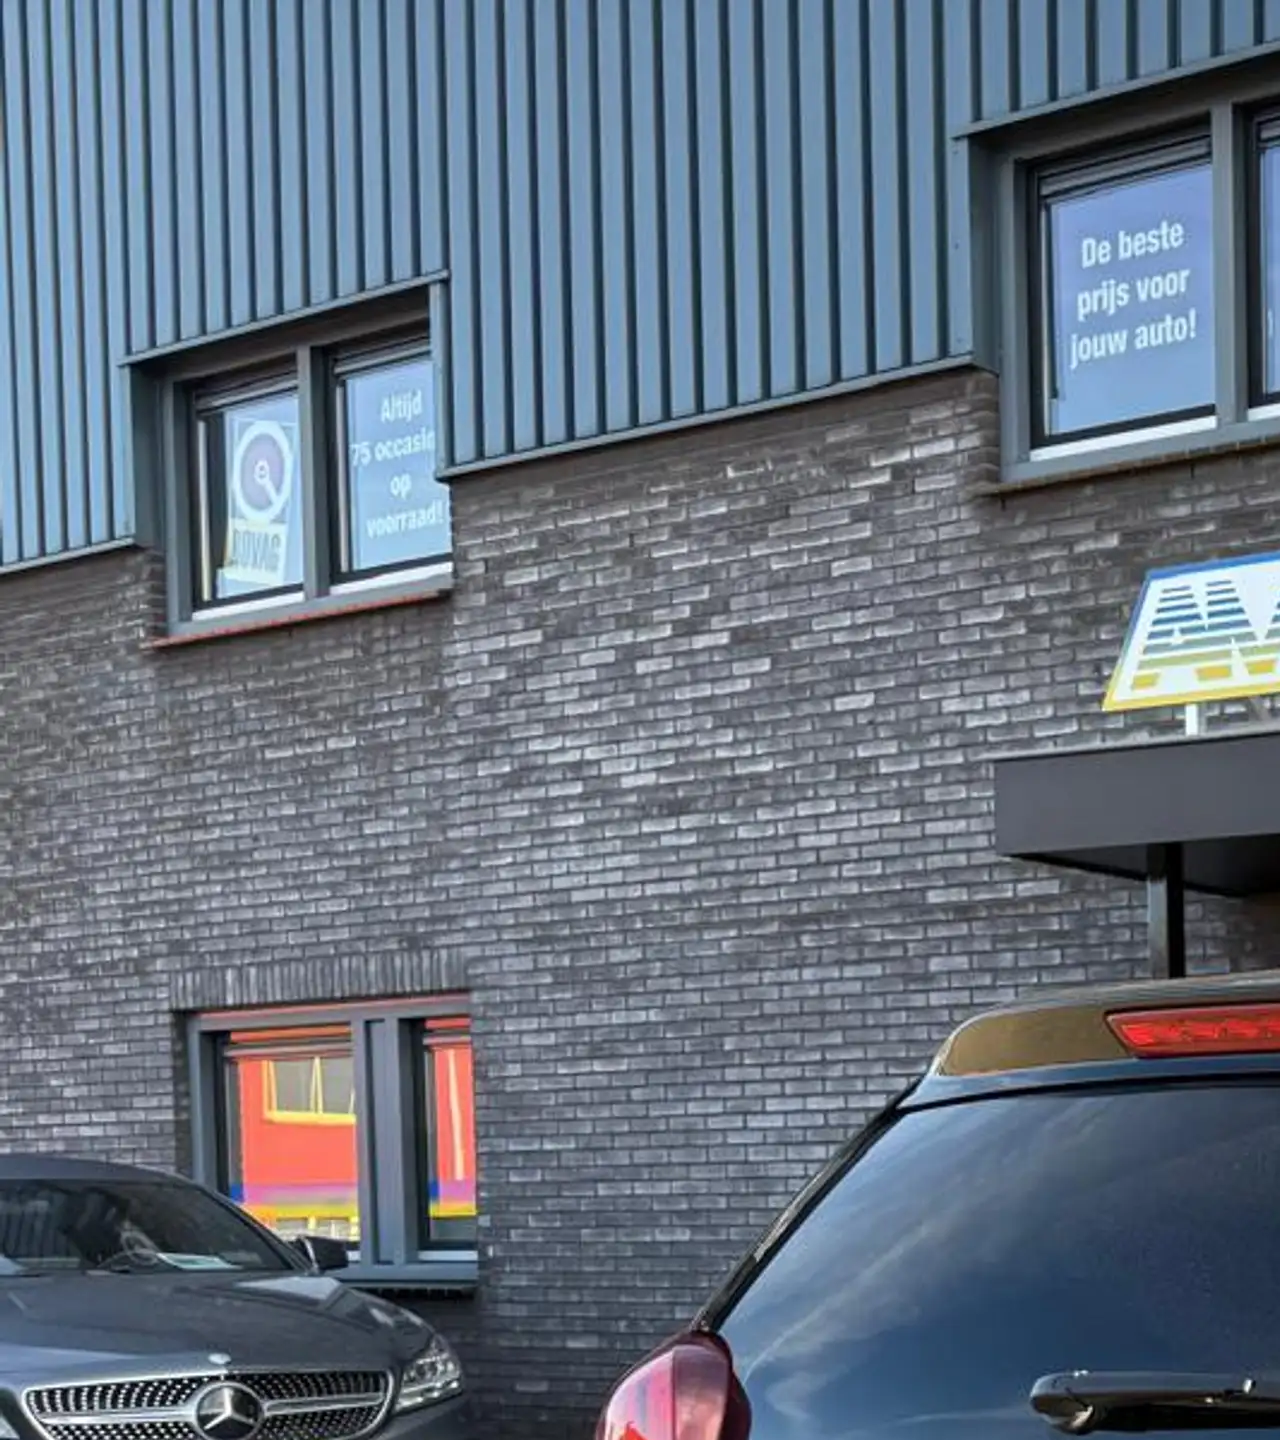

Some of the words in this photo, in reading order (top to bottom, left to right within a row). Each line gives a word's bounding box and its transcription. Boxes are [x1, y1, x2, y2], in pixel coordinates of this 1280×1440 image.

[1082, 237, 1112, 269] De
[1118, 220, 1185, 260] beste
[1077, 278, 1130, 322] prijs
[1136, 269, 1191, 302] voor
[1069, 333, 1128, 370] jouw
[1134, 307, 1197, 350] auto!
[380, 389, 423, 424] Altijd
[350, 441, 371, 467] 75
[390, 473, 411, 499] op
[366, 501, 445, 539] voorraad!
